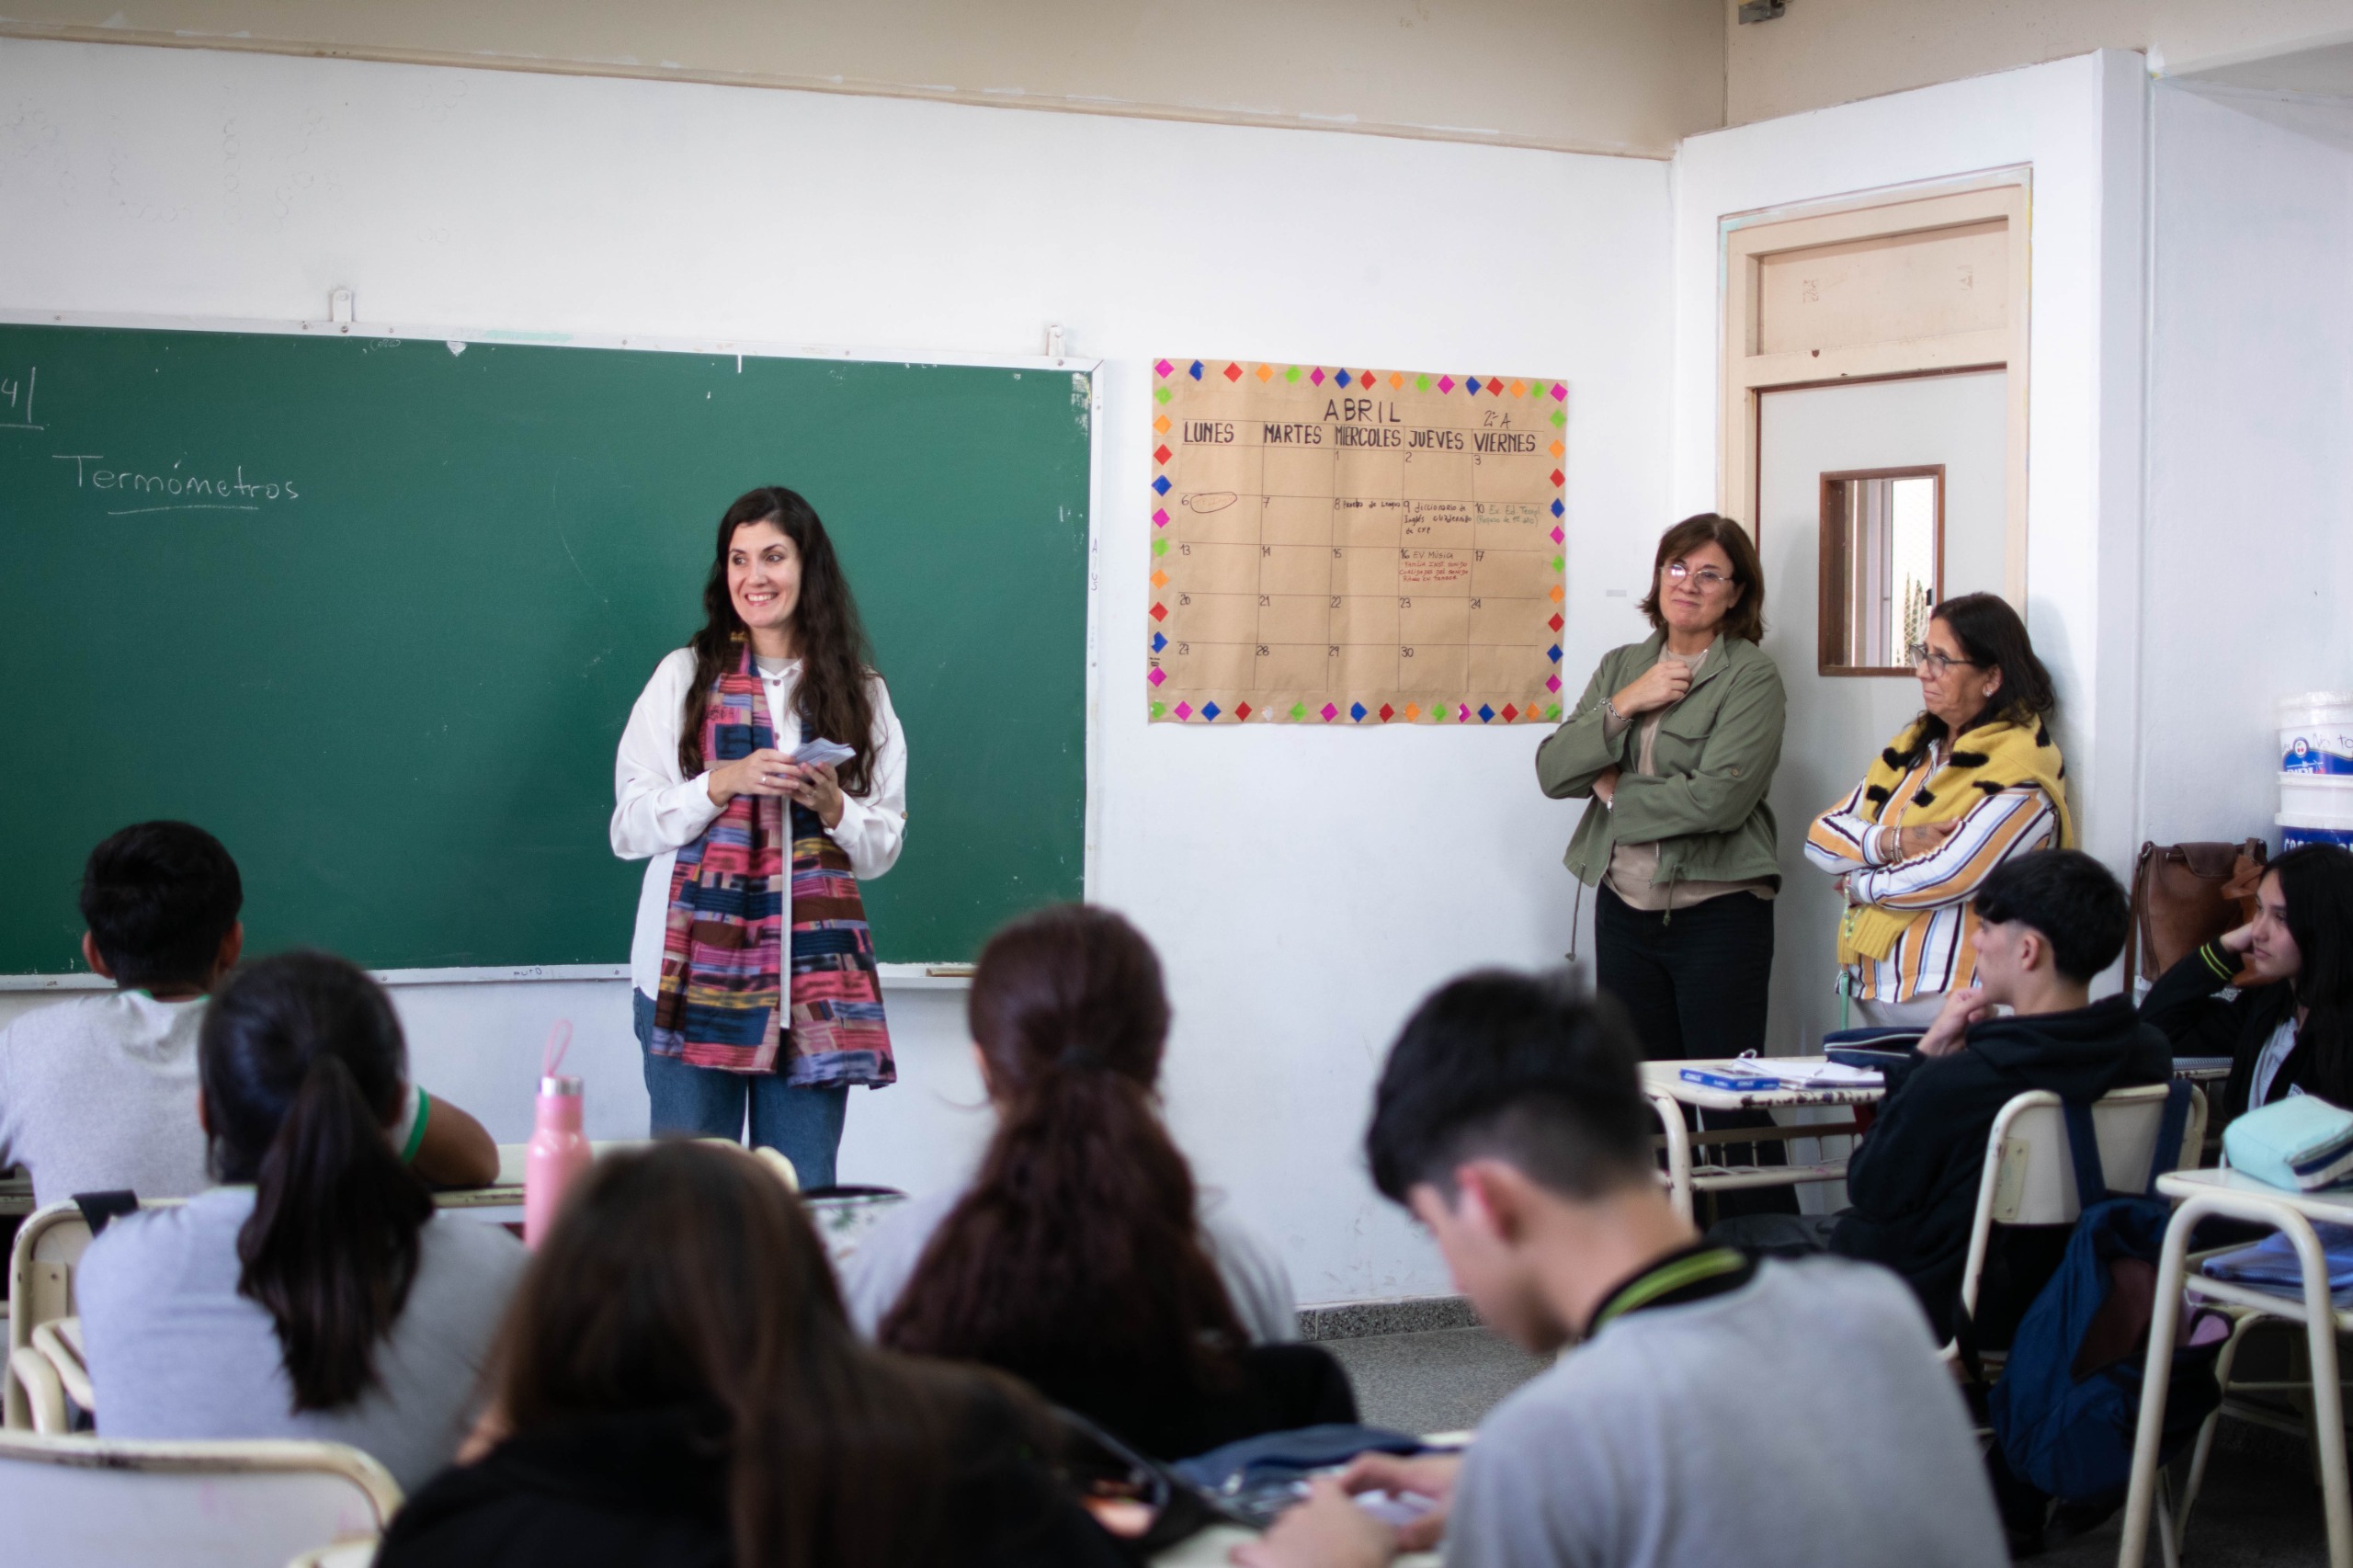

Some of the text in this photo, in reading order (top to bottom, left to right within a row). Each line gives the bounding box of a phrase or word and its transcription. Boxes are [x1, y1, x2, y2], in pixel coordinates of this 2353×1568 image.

[1324, 398, 1402, 423] ABRIL
[1500, 413, 1511, 429] A
[1182, 421, 1536, 453] LUNES MARTES MIERCOLES JUEVES VIERNES
[1404, 451, 1412, 462] 2
[1473, 454, 1481, 465] 3
[52, 454, 299, 500] Termómetros
[1181, 494, 1189, 506] 6
[1263, 496, 1270, 509] 7
[1334, 498, 1341, 510] 8
[1403, 500, 1411, 513] 9
[1474, 502, 1485, 514] 10
[1179, 543, 1191, 556] 13
[1262, 545, 1271, 558] 14
[1333, 548, 1342, 559] 15
[1400, 548, 1411, 559] 16
[1475, 551, 1484, 562] 17
[1179, 594, 1191, 606] 20
[1259, 595, 1271, 608] 21
[1330, 596, 1342, 608] 22
[1400, 597, 1412, 608] 23
[1471, 597, 1482, 609] 24
[1178, 643, 1189, 655] 27
[1256, 644, 1270, 656] 28
[1328, 645, 1340, 657] 29
[1401, 646, 1415, 658] 30
